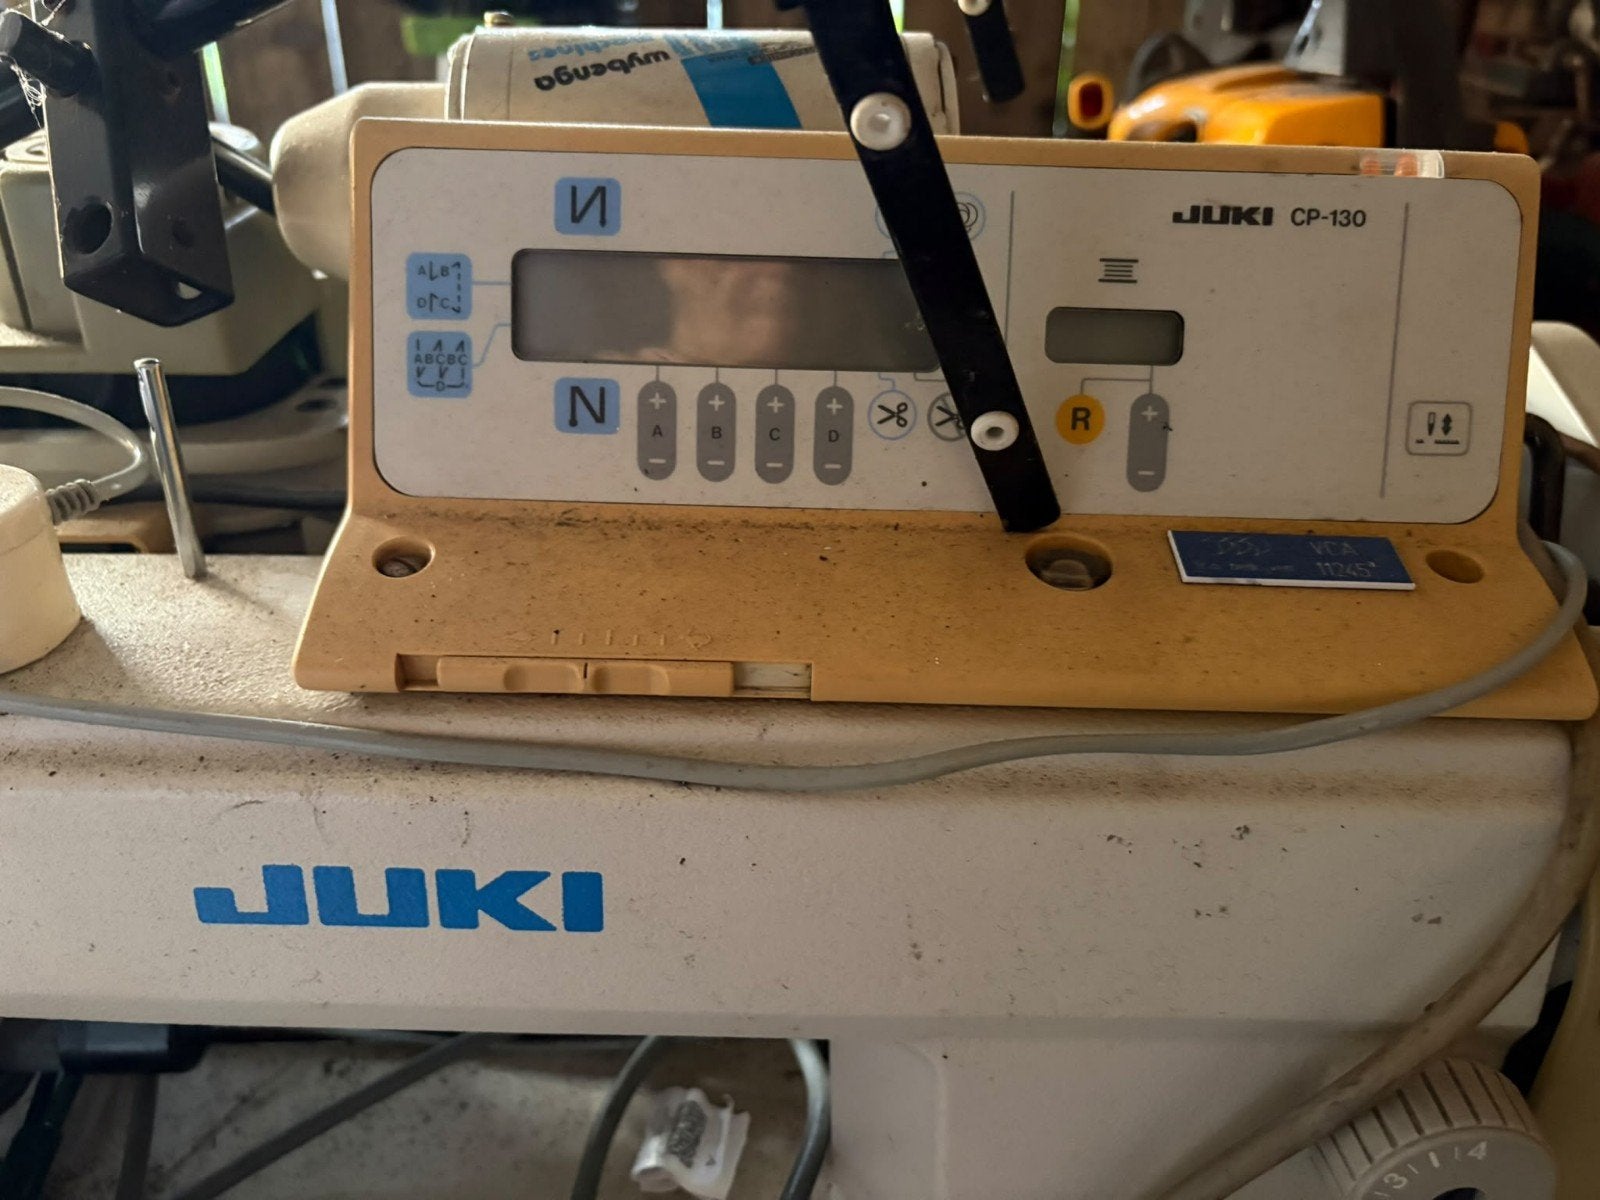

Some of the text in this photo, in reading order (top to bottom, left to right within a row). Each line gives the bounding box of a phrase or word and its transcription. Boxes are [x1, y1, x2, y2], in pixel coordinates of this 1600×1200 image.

[534, 50, 671, 91] wybenga
[1172, 205, 1367, 227] JUKI CP-130
[1070, 407, 1092, 431] R
[652, 424, 664, 438] A
[711, 426, 722, 440] B
[768, 427, 781, 442] C
[827, 429, 840, 443] D
[193, 864, 605, 933] JUKI
[1466, 1140, 1488, 1160] 4
[1383, 1172, 1409, 1190] 3
